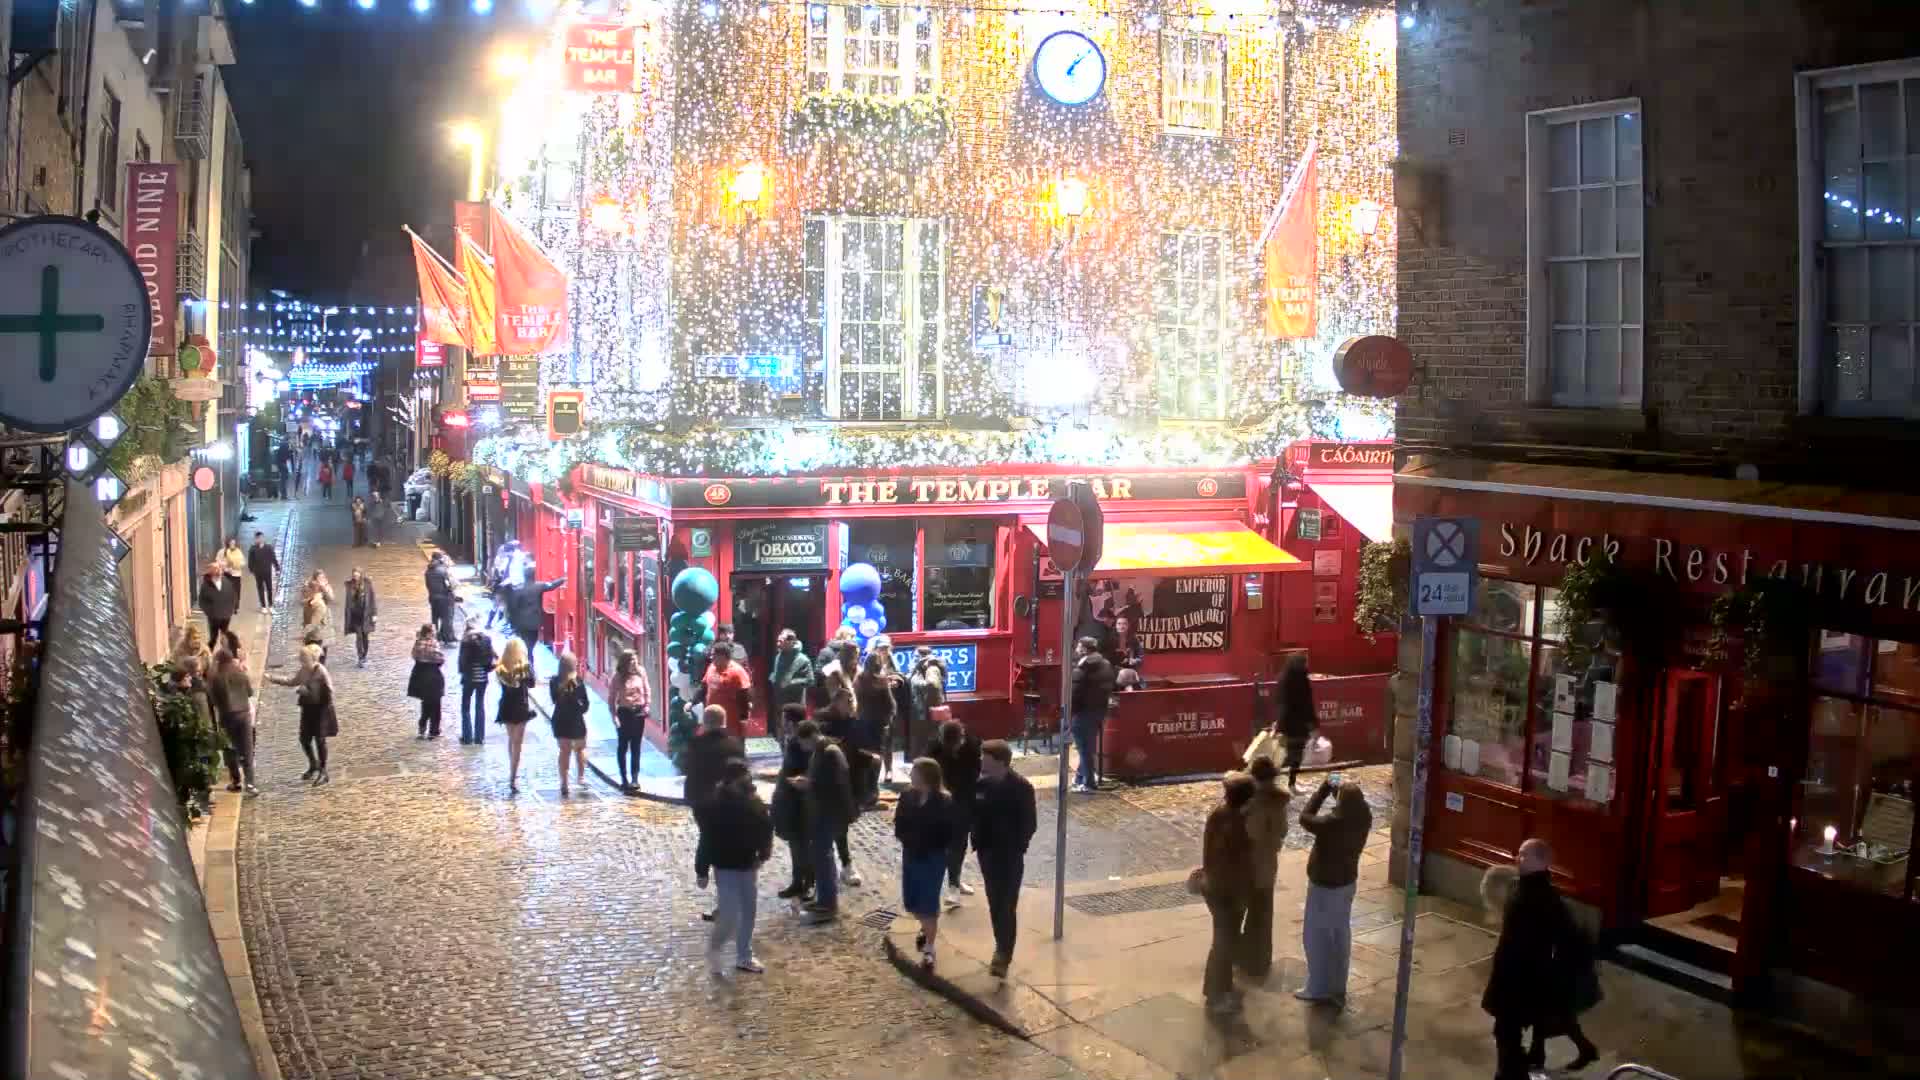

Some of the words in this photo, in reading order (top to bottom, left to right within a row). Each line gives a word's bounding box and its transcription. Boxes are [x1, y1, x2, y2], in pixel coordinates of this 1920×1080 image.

[586, 30, 617, 45] THE
[567, 48, 634, 64] TEMPLE
[584, 70, 617, 84] BAR
[136, 172, 169, 232] NINE
[520, 304, 546, 314] THE
[502, 312, 561, 327] TEMPLE
[516, 327, 548, 338] BAR
[89, 303, 137, 400] PHARMACY
[710, 488, 726, 498] 48
[823, 481, 898, 503] THE
[912, 478, 1050, 501] TEMPLE
[751, 538, 816, 561] TOBACCO
[1500, 522, 1620, 567] Shack
[1176, 578, 1226, 594] EMPEROR
[1422, 583, 1442, 603] 24
[1212, 594, 1224, 608] OF
[1137, 617, 1181, 632] MALTED
[1183, 608, 1226, 629] LIQUORS
[1176, 712, 1198, 720] THE
[1147, 720, 1197, 735] TEMPLE
[1200, 718, 1225, 730] BAR
